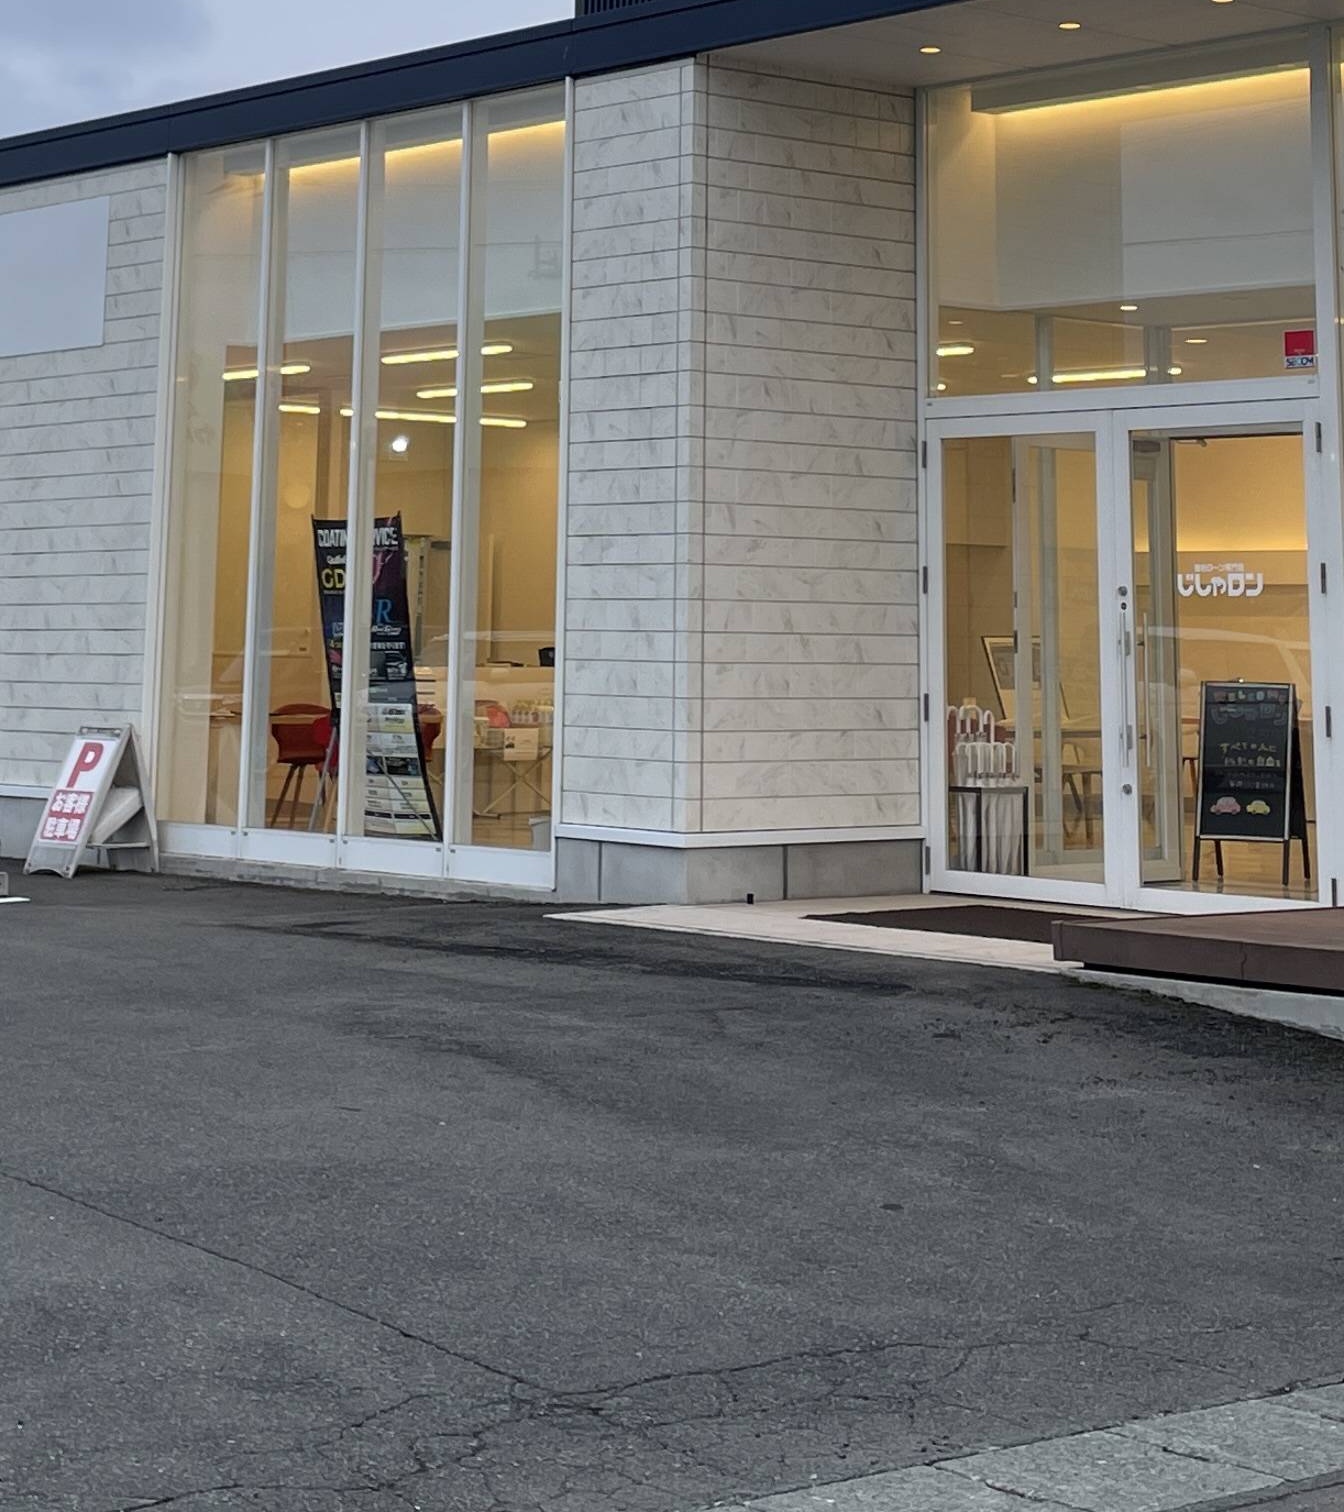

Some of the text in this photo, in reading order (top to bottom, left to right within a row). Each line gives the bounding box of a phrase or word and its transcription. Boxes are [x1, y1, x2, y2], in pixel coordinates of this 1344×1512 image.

[1177, 572, 1264, 597] じしゃロン
[65, 741, 105, 789] P
